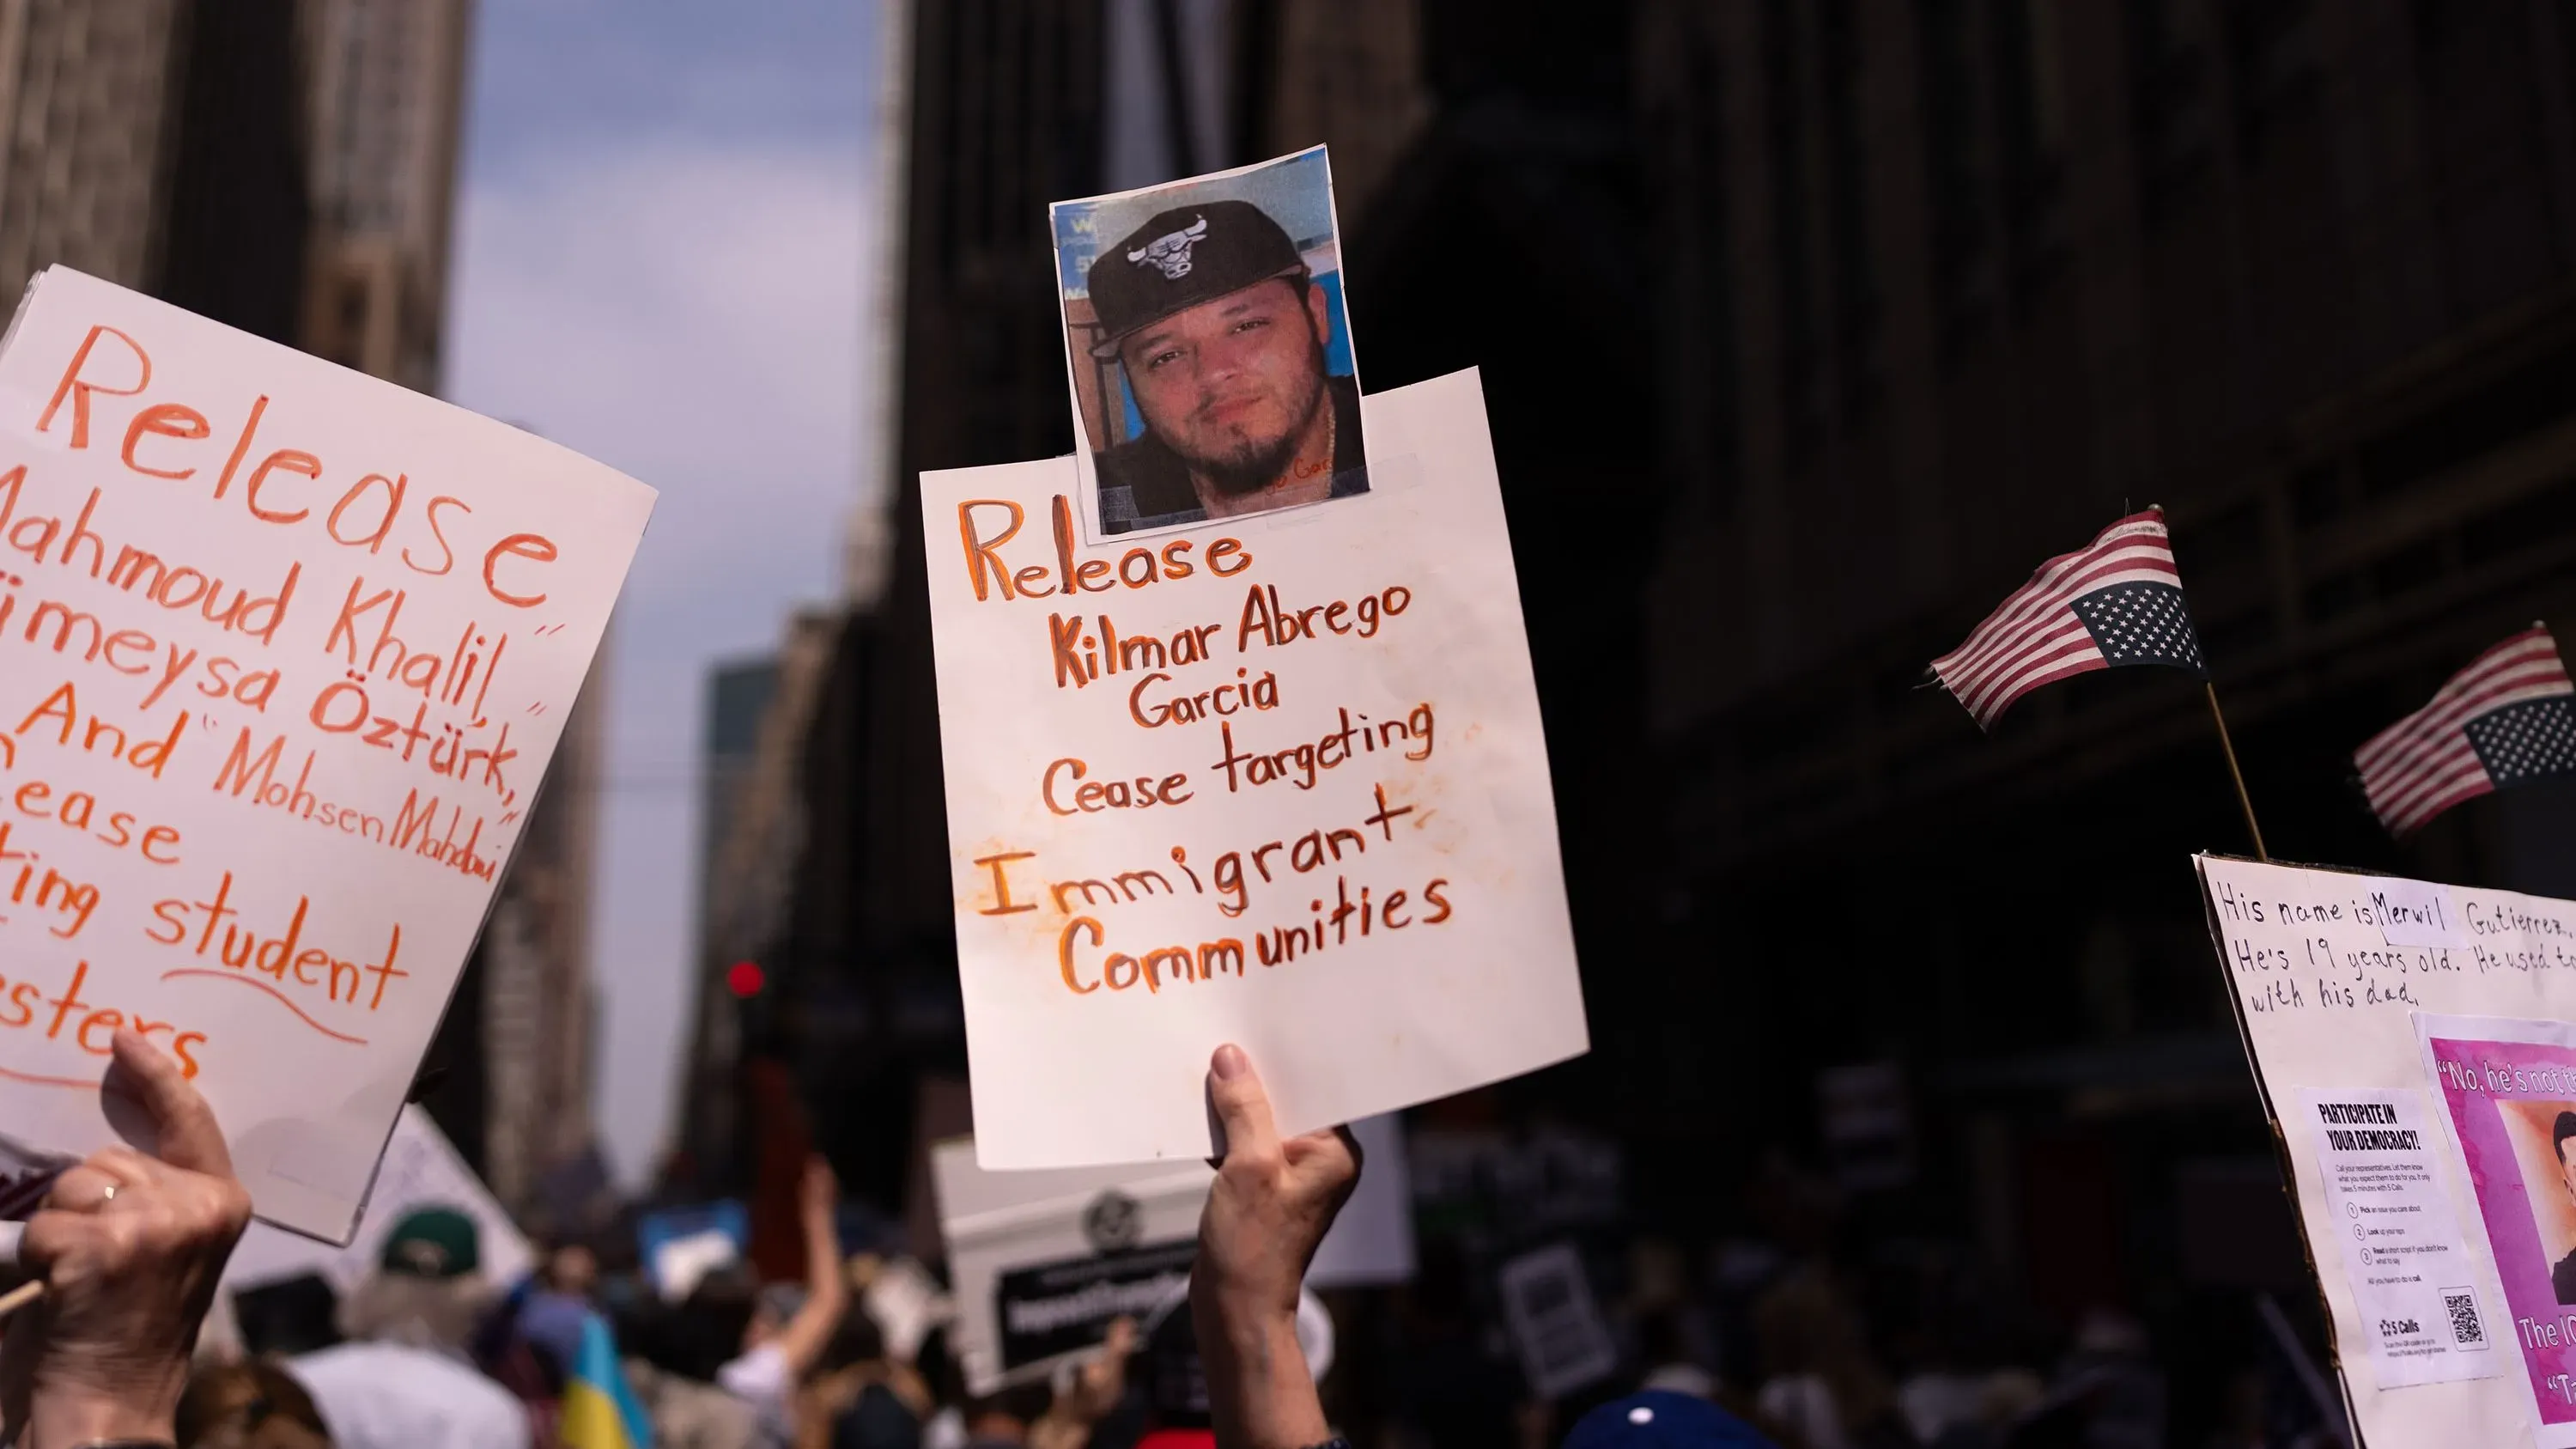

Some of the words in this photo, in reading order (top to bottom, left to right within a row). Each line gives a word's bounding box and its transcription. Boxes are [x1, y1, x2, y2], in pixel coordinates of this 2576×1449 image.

[34, 324, 558, 608] Release
[957, 493, 1253, 601] Release
[1048, 612, 1223, 688] Kilmar
[1237, 583, 1411, 654] Abrego
[1128, 667, 1279, 728] Garcia
[15, 681, 189, 780] And
[1042, 758, 1194, 816] Cease
[1211, 702, 1435, 790] targeting
[974, 782, 1413, 916] Immigrant
[1059, 875, 1453, 995] Communities
[2217, 881, 2264, 922] His
[2278, 903, 2342, 926] name
[2352, 899, 2373, 926] is
[2371, 892, 2445, 931] Merwil
[144, 871, 410, 1011] student
[2234, 938, 2289, 971] He's
[2306, 938, 2336, 969] 19
[2348, 951, 2407, 981] years
[2419, 947, 2461, 972] old.
[2473, 944, 2501, 974] He
[2506, 942, 2551, 971] used
[2251, 978, 2305, 1012] with
[2319, 978, 2354, 1008] his
[2530, 1068, 2566, 1095] not
[2318, 1104, 2385, 1124] PARTICIPATE
[2383, 1104, 2397, 1124] IN
[2326, 1130, 2358, 1151] YOUR
[2354, 1130, 2421, 1151] DEMOCRACY!
[2391, 1321, 2397, 1335] 5
[2398, 1319, 2420, 1334] Calls
[2518, 1317, 2559, 1349] The
